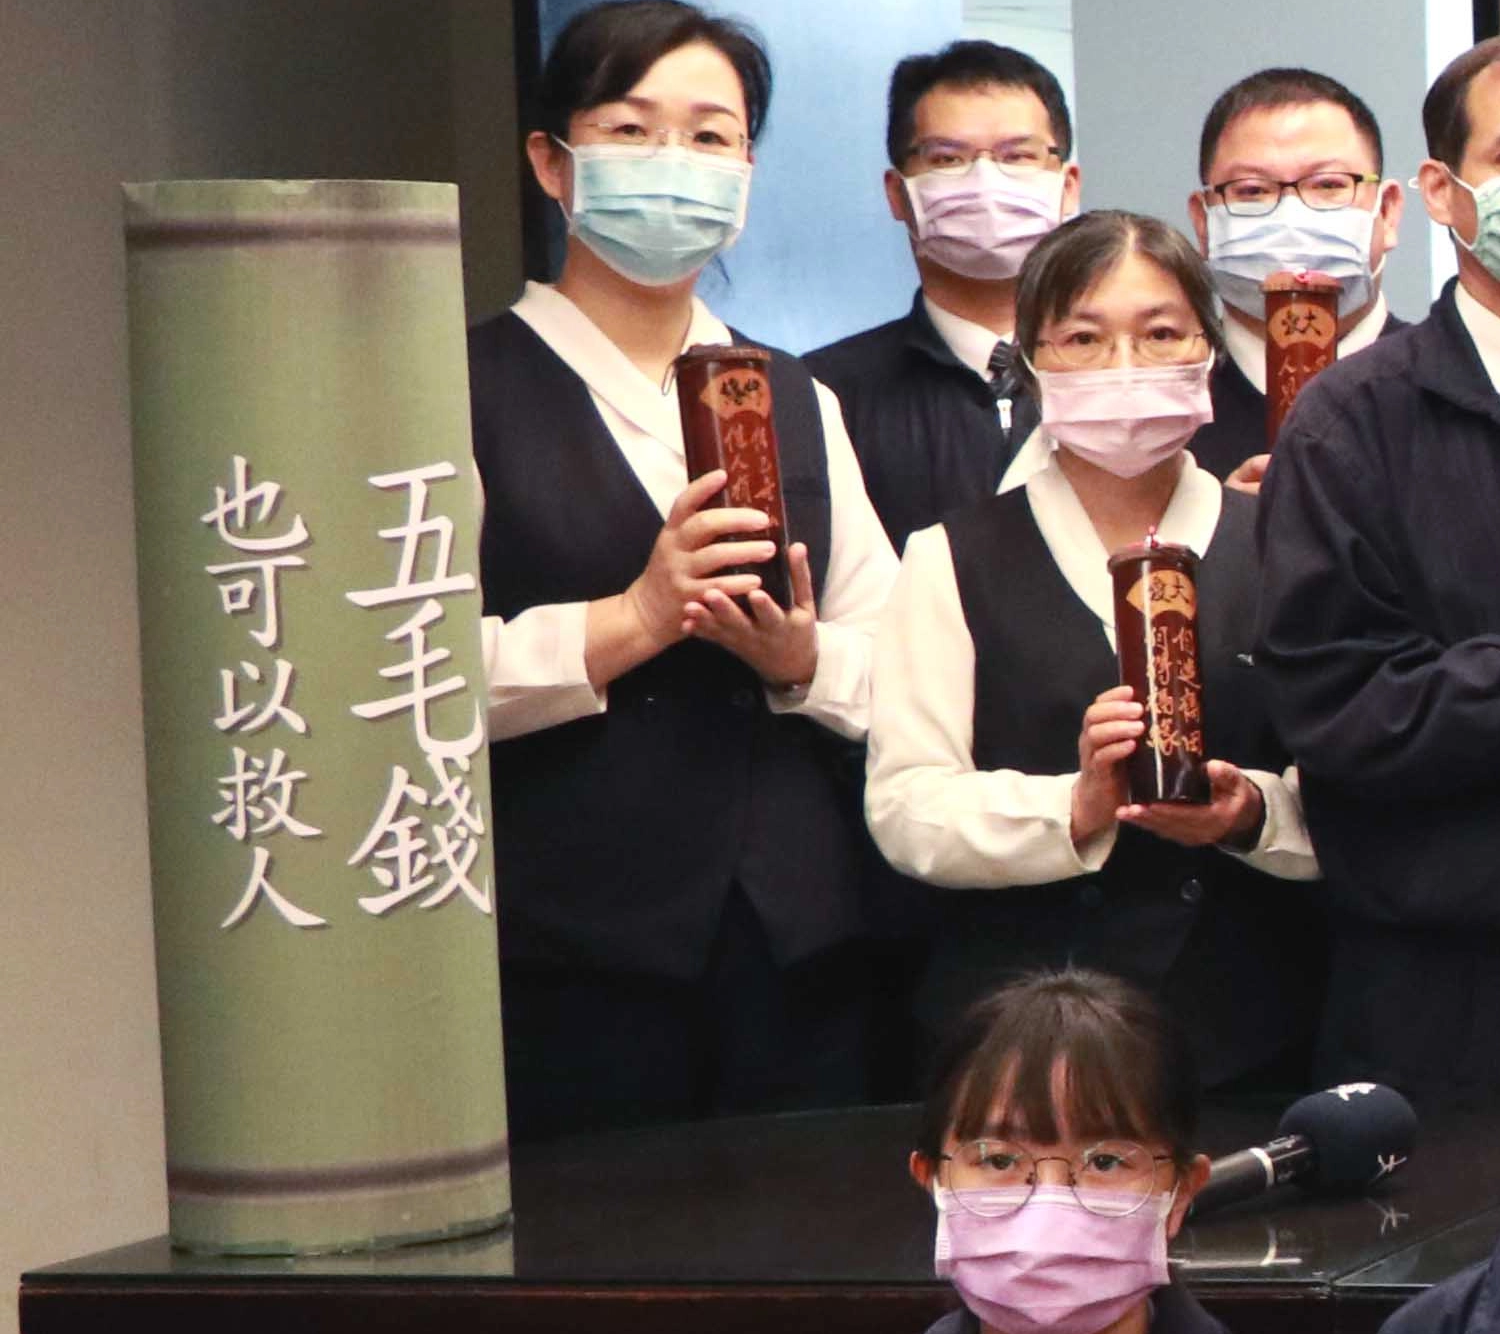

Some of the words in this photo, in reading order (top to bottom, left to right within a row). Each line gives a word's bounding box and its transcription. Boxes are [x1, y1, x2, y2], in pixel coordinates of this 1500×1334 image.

[201, 454, 327, 929] 也可以救人
[345, 460, 492, 915] 五毛錢
